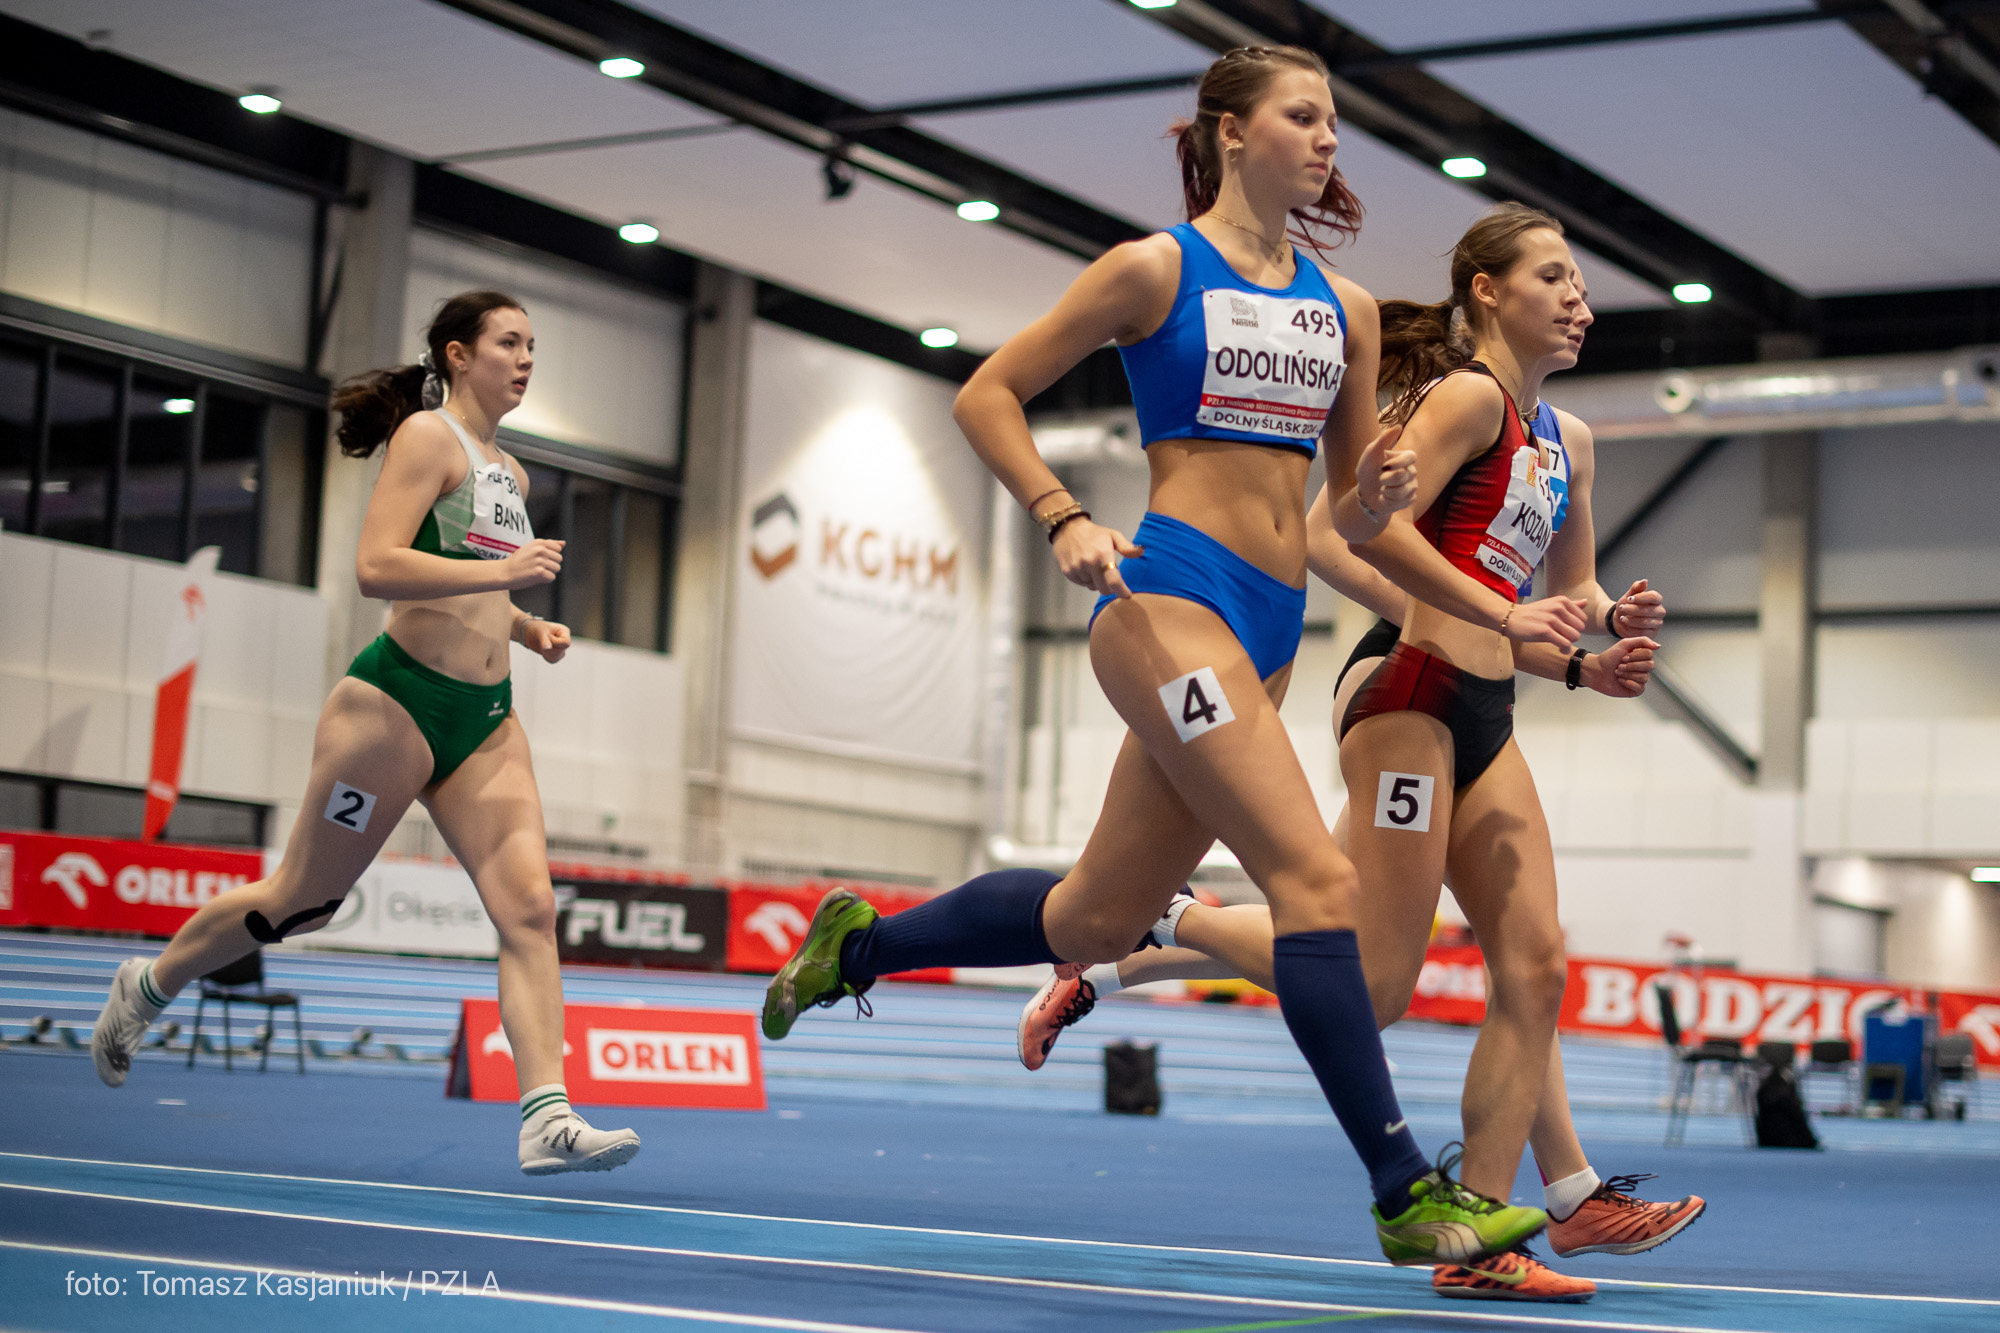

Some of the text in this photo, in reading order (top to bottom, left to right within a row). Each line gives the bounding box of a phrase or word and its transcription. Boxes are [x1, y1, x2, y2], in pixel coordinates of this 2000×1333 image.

[1231, 318, 1259, 328] Nestlé
[1290, 309, 1336, 338] 495
[1215, 346, 1342, 391] ODOLIŃSKA
[1206, 397, 1225, 406] PZLA
[1213, 411, 1259, 427] DOLNY
[1261, 415, 1301, 433] ŚLĄSK
[494, 502, 526, 535] BANY
[818, 514, 960, 597] KGHM
[1486, 538, 1500, 551] PZLA
[1182, 677, 1218, 725] 4
[333, 790, 365, 828] 2
[1387, 777, 1420, 825] 5
[601, 1041, 735, 1073] ORLEN
